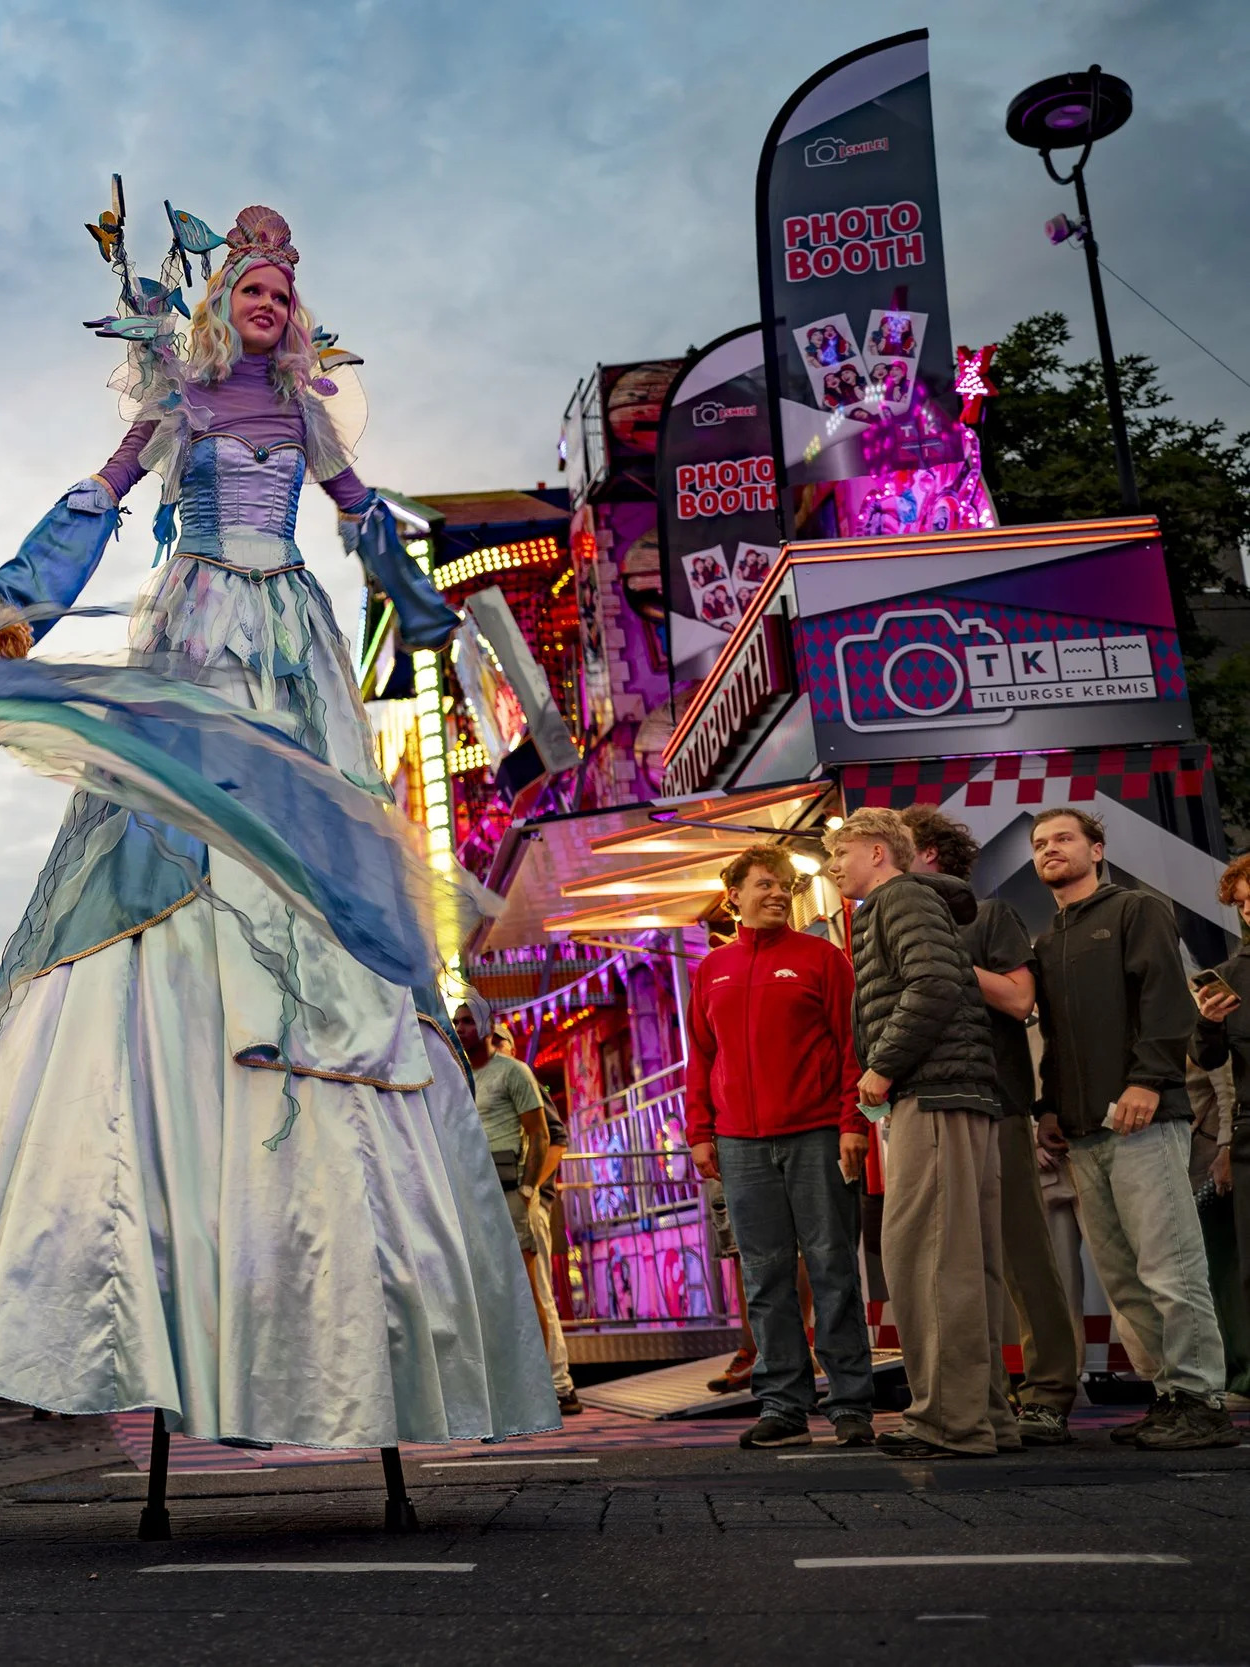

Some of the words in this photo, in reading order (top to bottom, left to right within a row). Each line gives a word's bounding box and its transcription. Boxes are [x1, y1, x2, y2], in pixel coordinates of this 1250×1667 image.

[783, 201, 922, 249] PHOTO
[784, 232, 926, 282] BOOTH
[676, 455, 776, 493] PHOTO
[677, 483, 778, 520] BOOTH
[978, 687, 1075, 704] TILBURGSE
[1083, 682, 1150, 698] KERMIS
